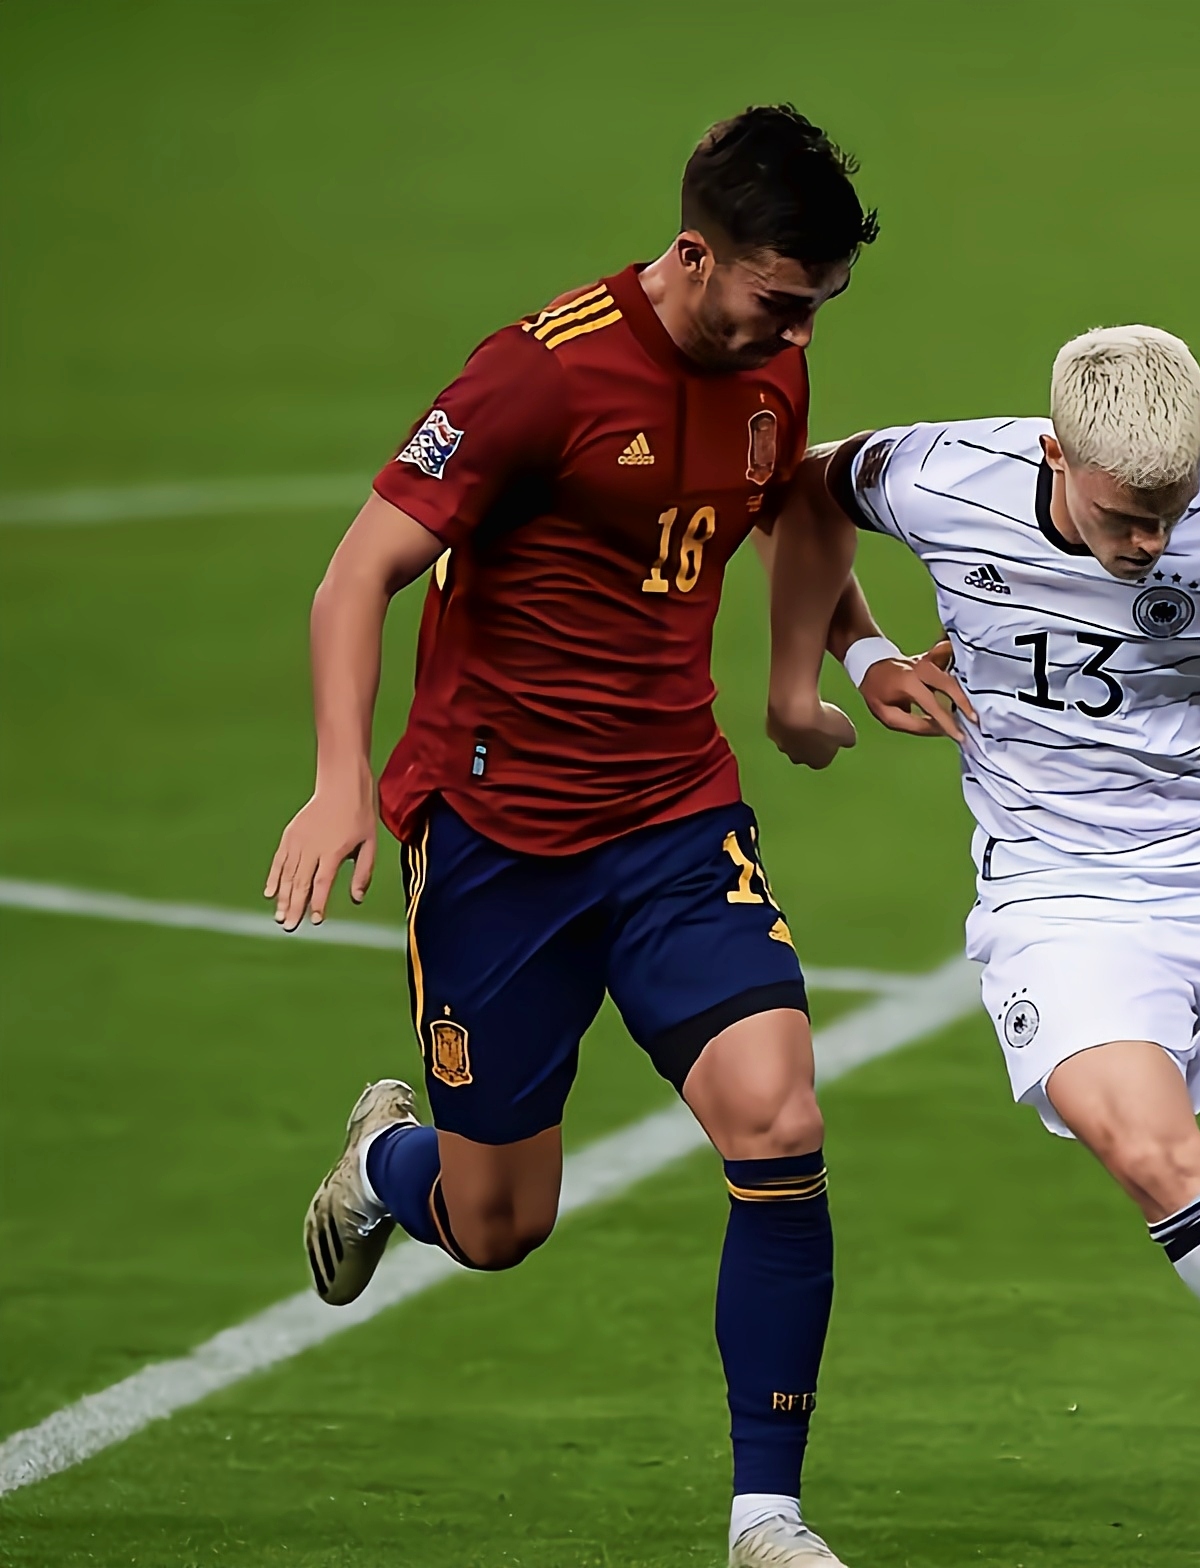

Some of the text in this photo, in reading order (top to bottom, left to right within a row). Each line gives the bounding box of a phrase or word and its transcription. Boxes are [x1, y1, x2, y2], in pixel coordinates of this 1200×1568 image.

[642, 505, 716, 593] 18
[1014, 630, 1124, 718] 13
[723, 825, 780, 903] 1
